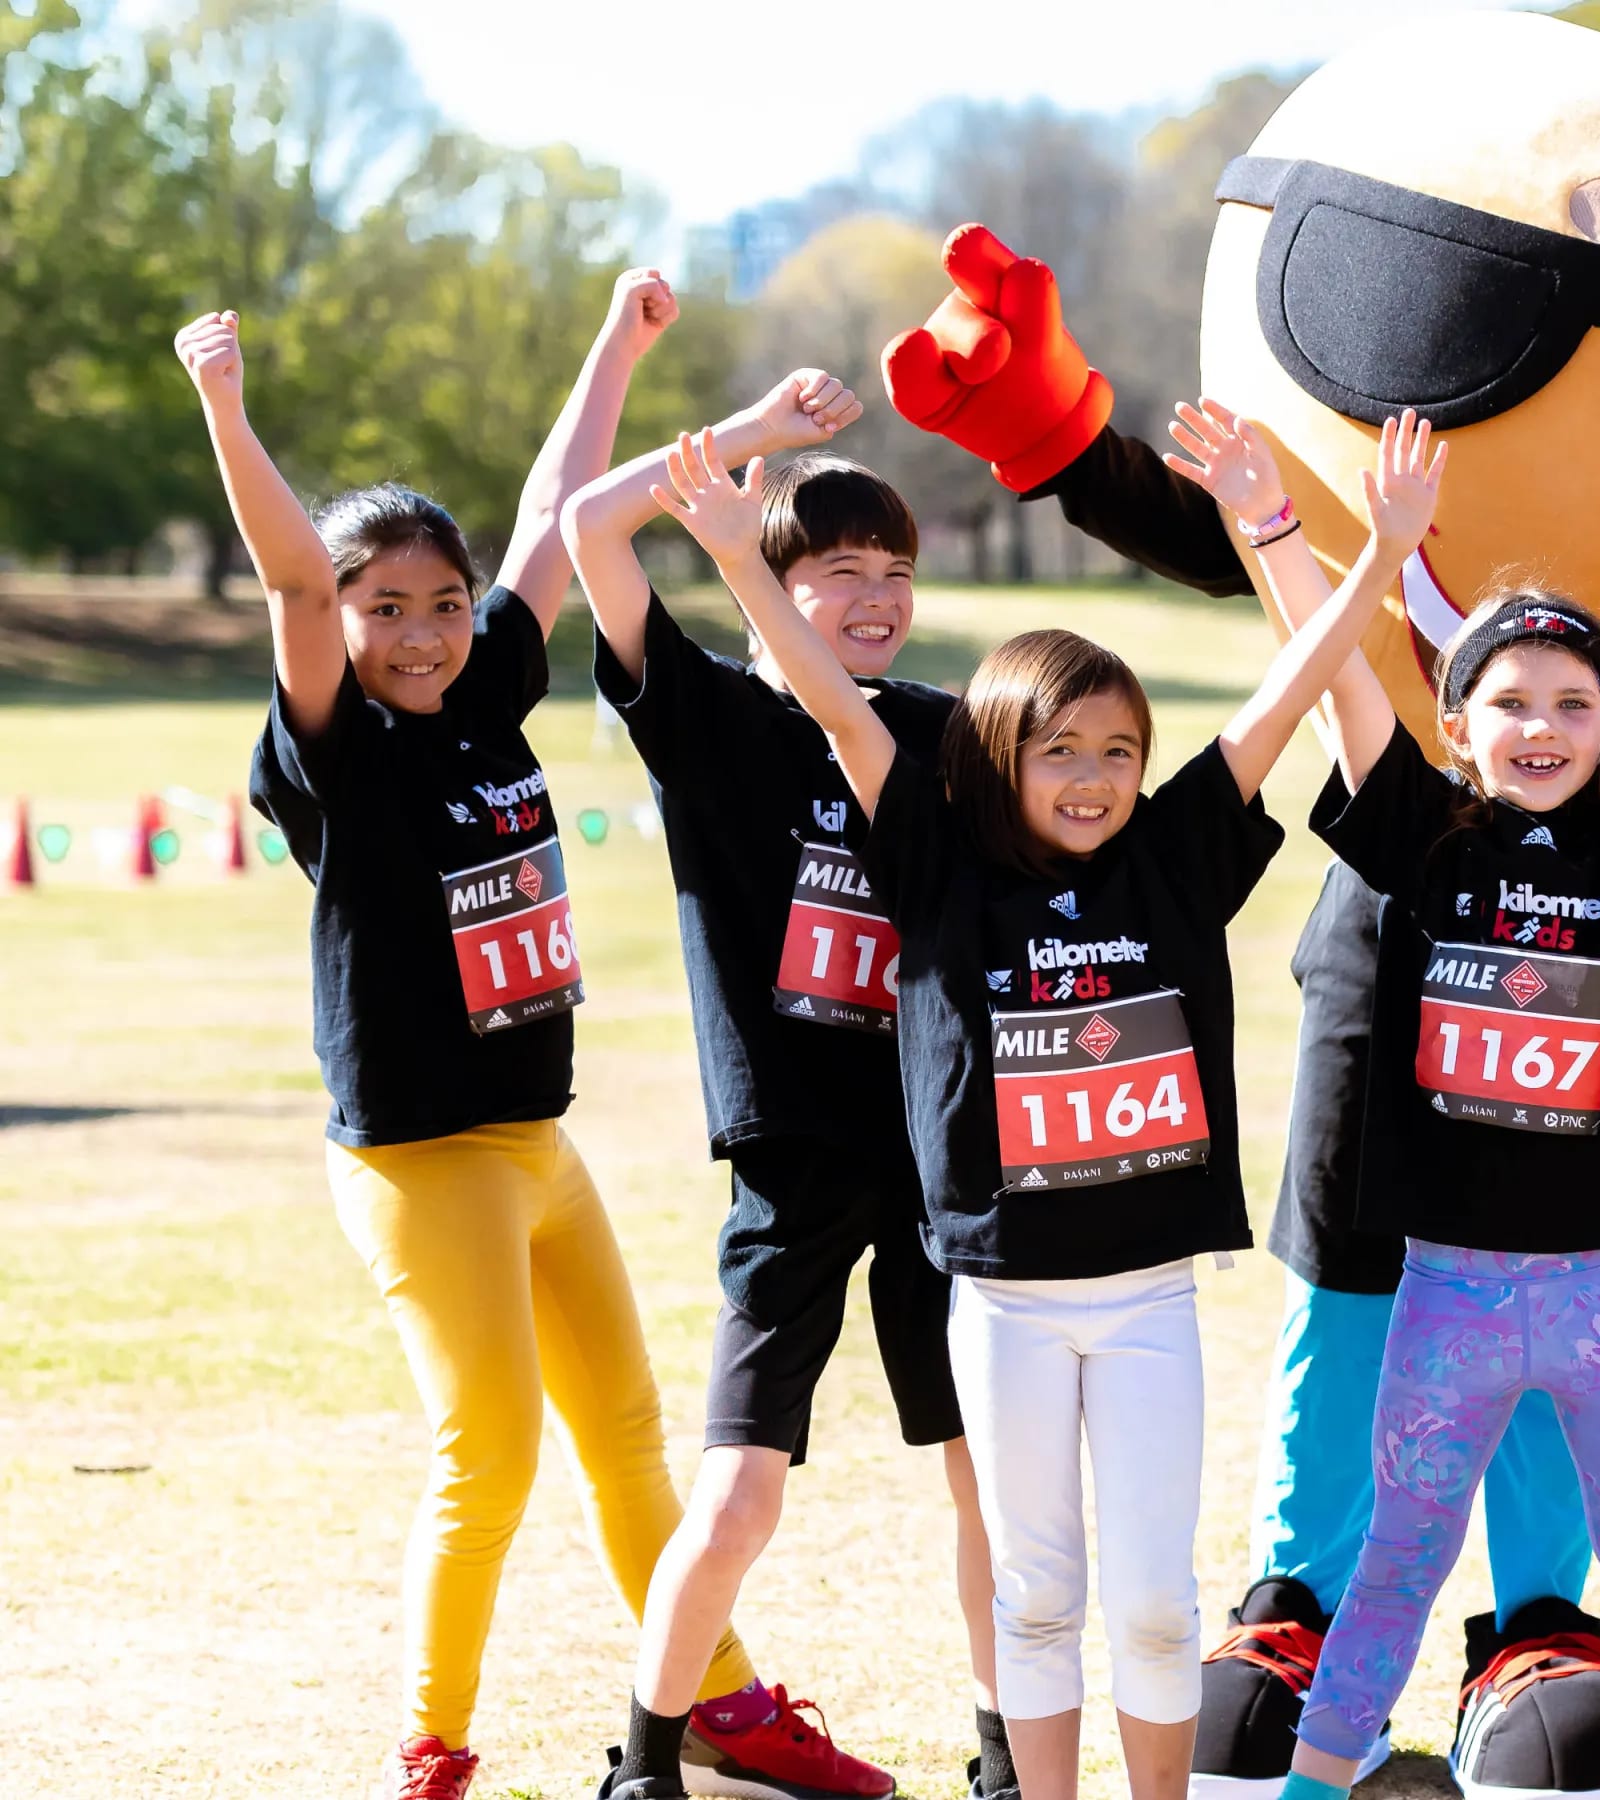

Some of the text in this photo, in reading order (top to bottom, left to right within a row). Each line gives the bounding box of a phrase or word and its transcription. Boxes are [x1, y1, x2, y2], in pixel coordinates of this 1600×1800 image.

[451, 873, 513, 915] MILE
[1027, 936, 1149, 971] kilometer
[1425, 958, 1498, 991] MILE
[523, 999, 554, 1016] DASANI
[789, 1004, 816, 1017] adidas
[831, 1007, 865, 1024] DASANI
[486, 1016, 513, 1029] adidas
[995, 1028, 1070, 1057] MILE
[1439, 1022, 1600, 1091] 1167
[1021, 1073, 1188, 1147] 1164
[1461, 1103, 1497, 1118] DASANI
[1560, 1114, 1588, 1129] PNC
[1162, 1148, 1191, 1165] PNC
[1063, 1167, 1101, 1181] DASANI
[1020, 1179, 1049, 1187] adidas
